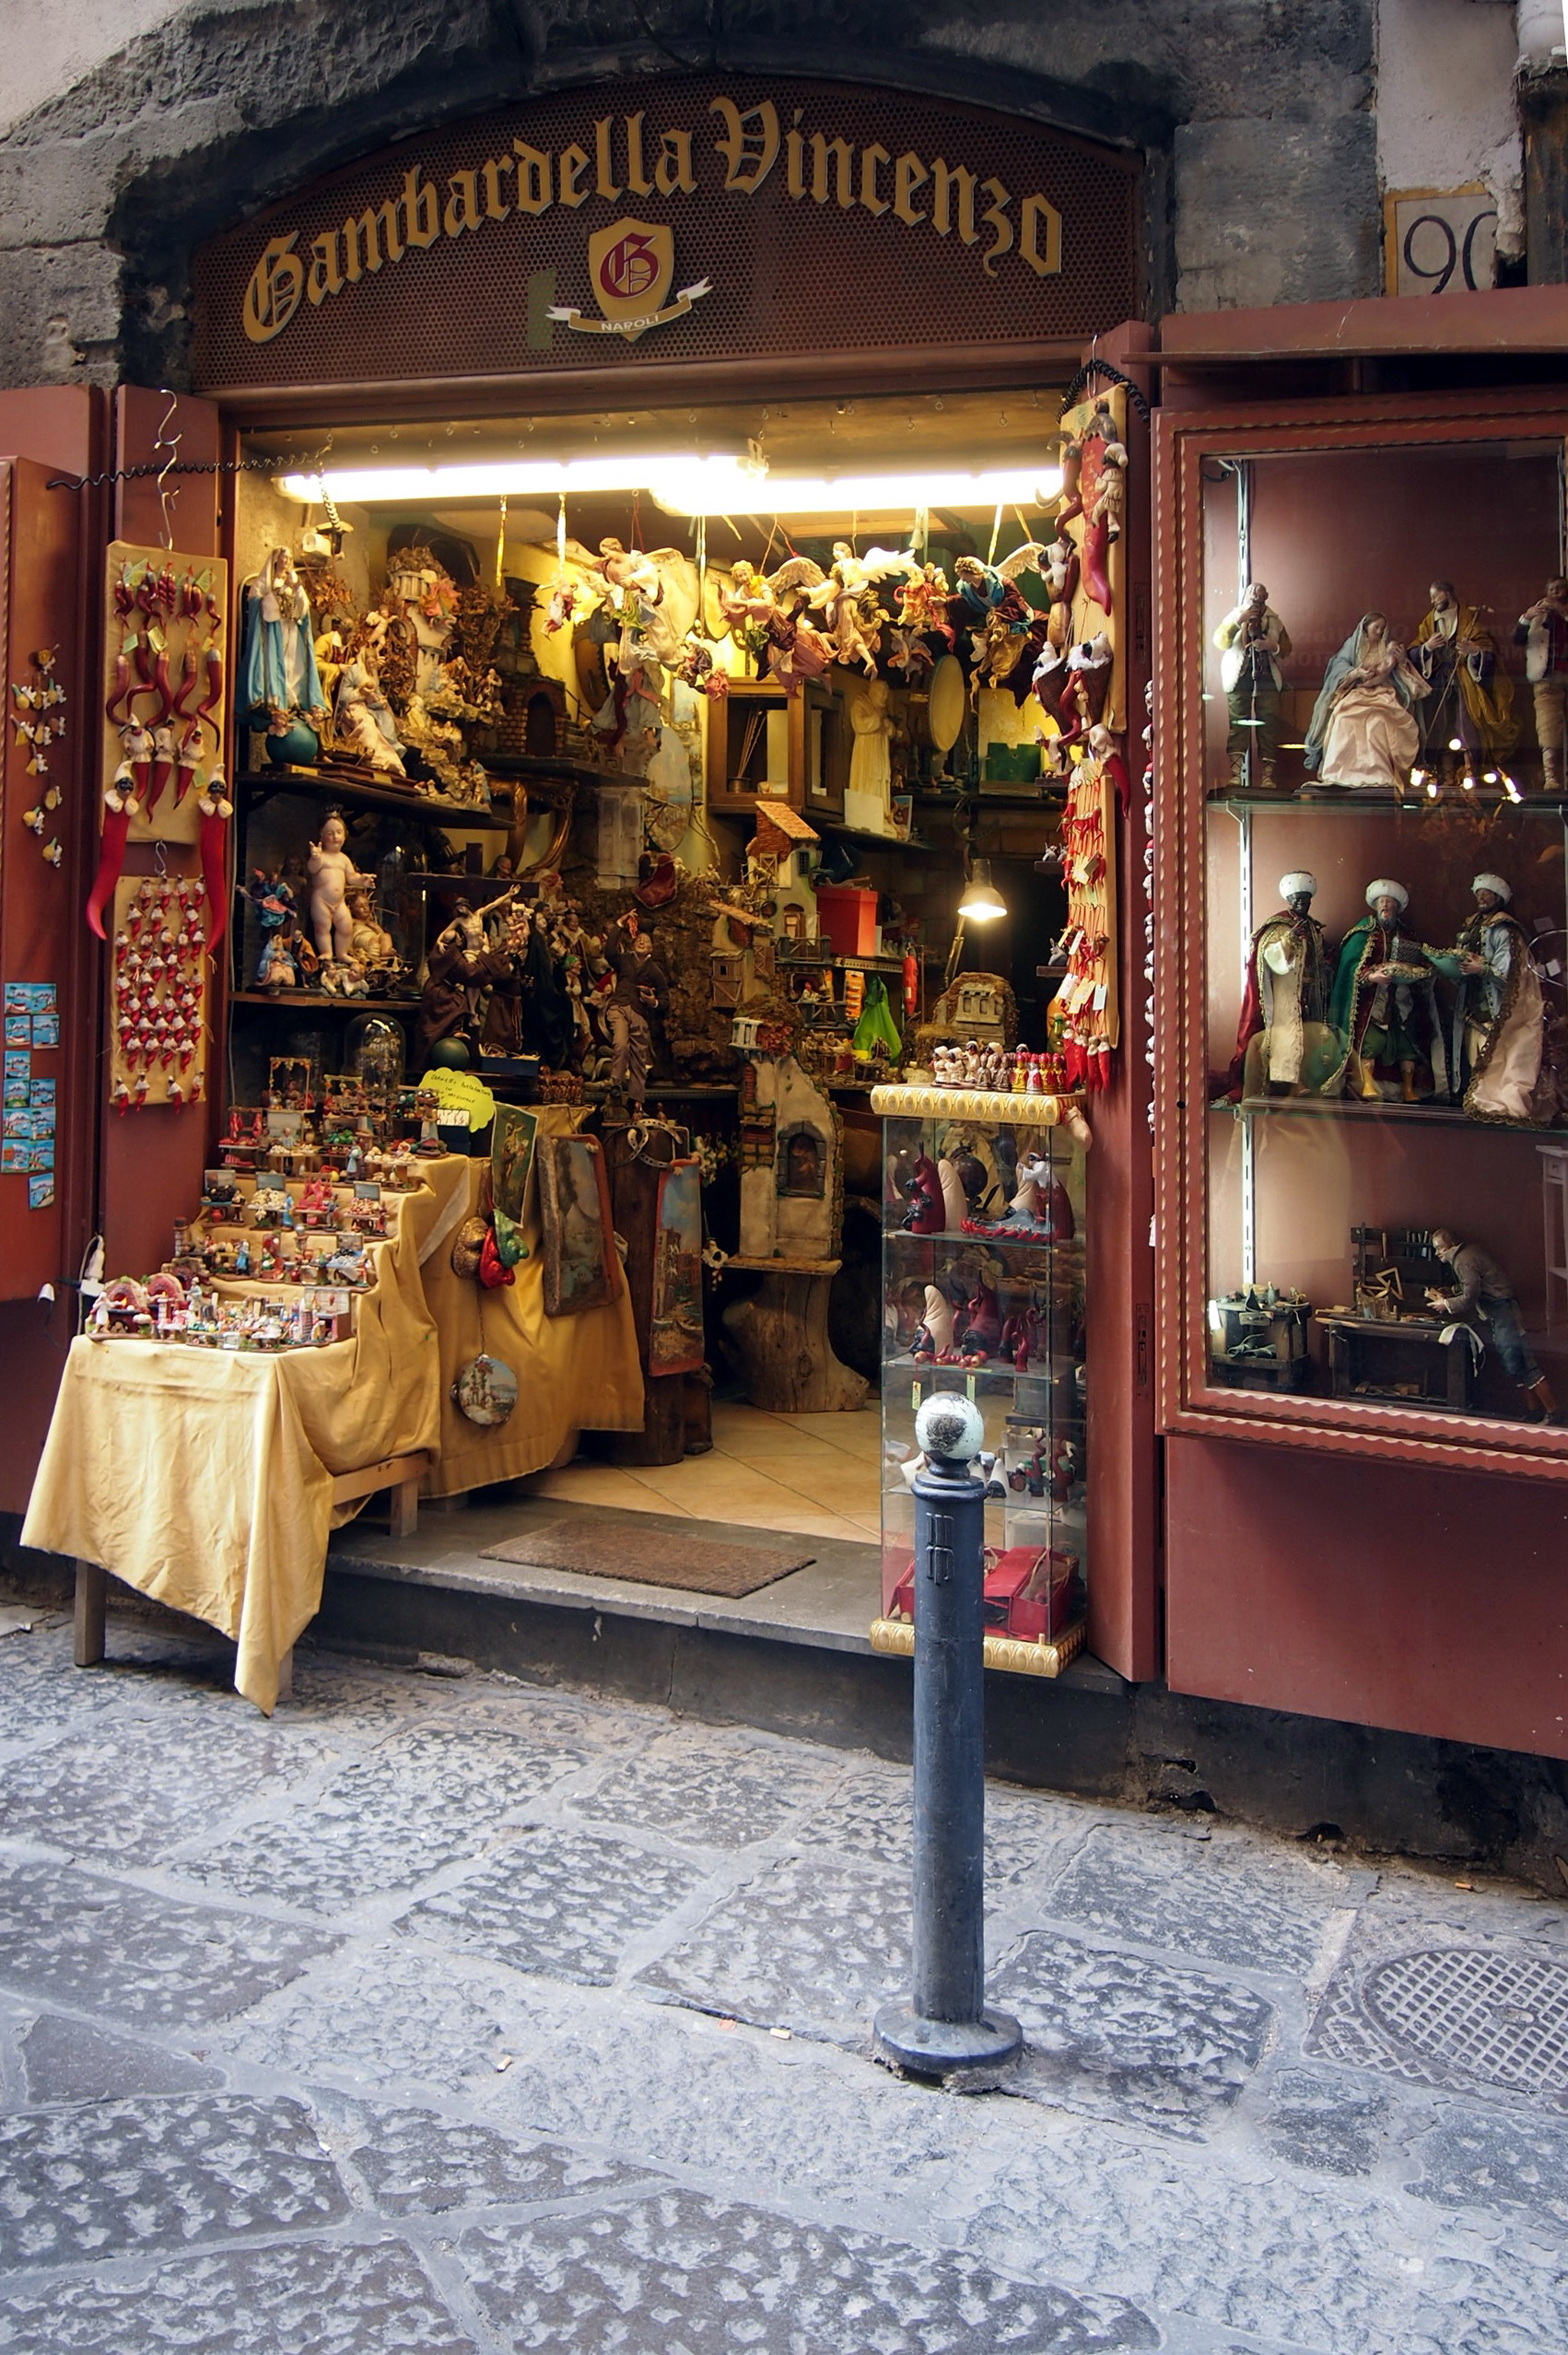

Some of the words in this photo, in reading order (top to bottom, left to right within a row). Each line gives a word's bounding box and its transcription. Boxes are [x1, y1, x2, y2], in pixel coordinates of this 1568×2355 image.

[243, 111, 698, 344] Gambardella
[708, 96, 1062, 277] Vincenzo
[600, 232, 660, 299] G
[601, 314, 660, 332] NAPOLI
